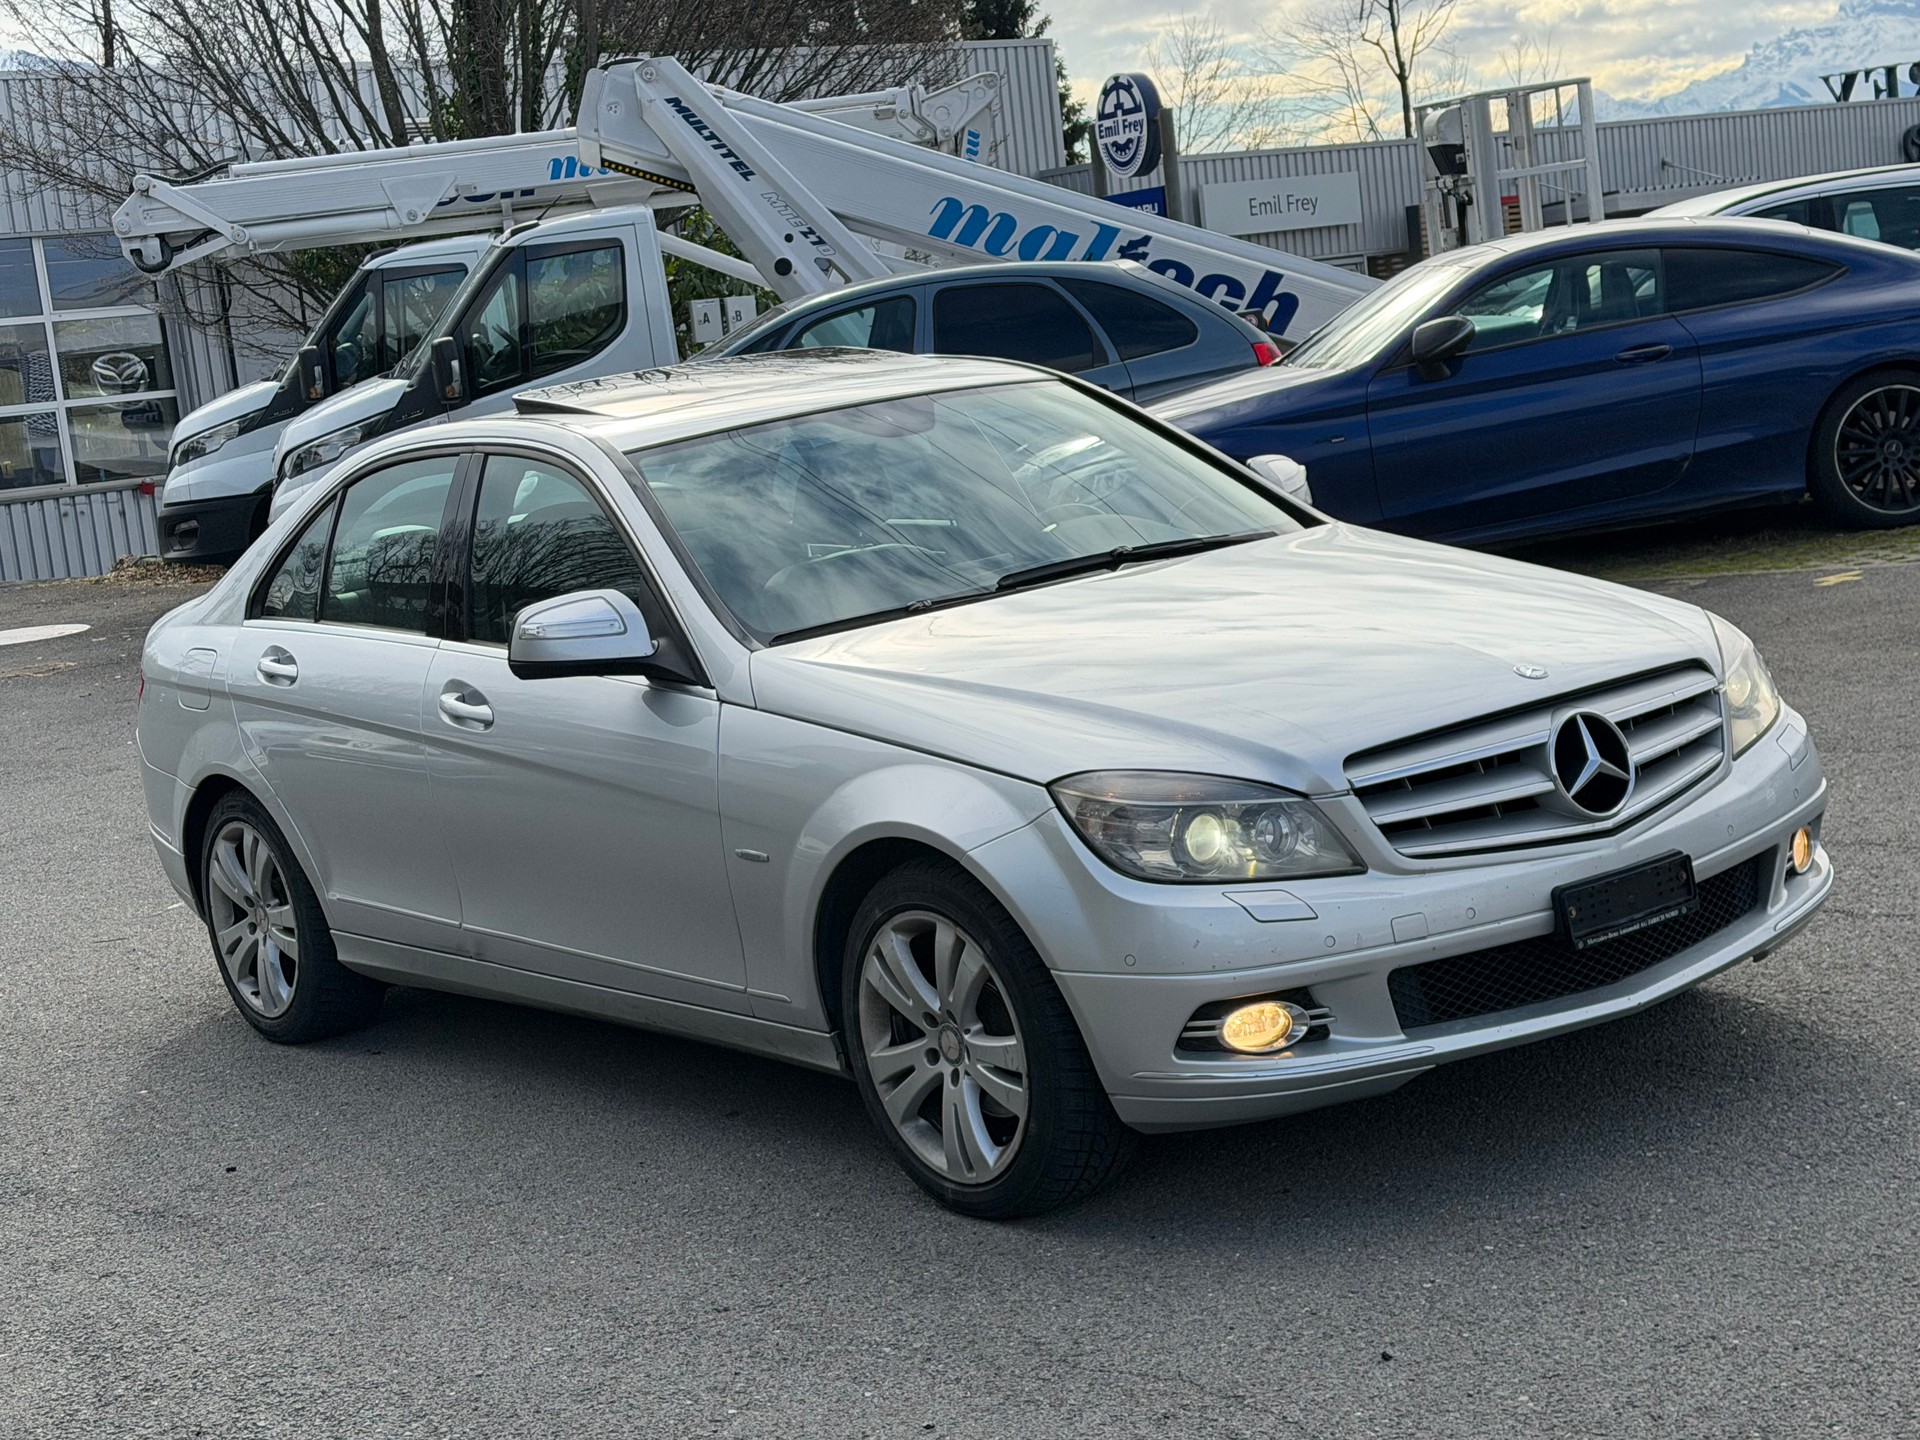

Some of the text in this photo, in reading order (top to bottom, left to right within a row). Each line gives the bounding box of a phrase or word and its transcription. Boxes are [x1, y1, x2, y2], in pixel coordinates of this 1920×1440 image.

[664, 96, 757, 182] MULTITEL
[1098, 118, 1144, 140] Emil Frey
[1249, 194, 1318, 217] Emil Frey
[703, 311, 711, 324] A
[734, 310, 743, 322] B
